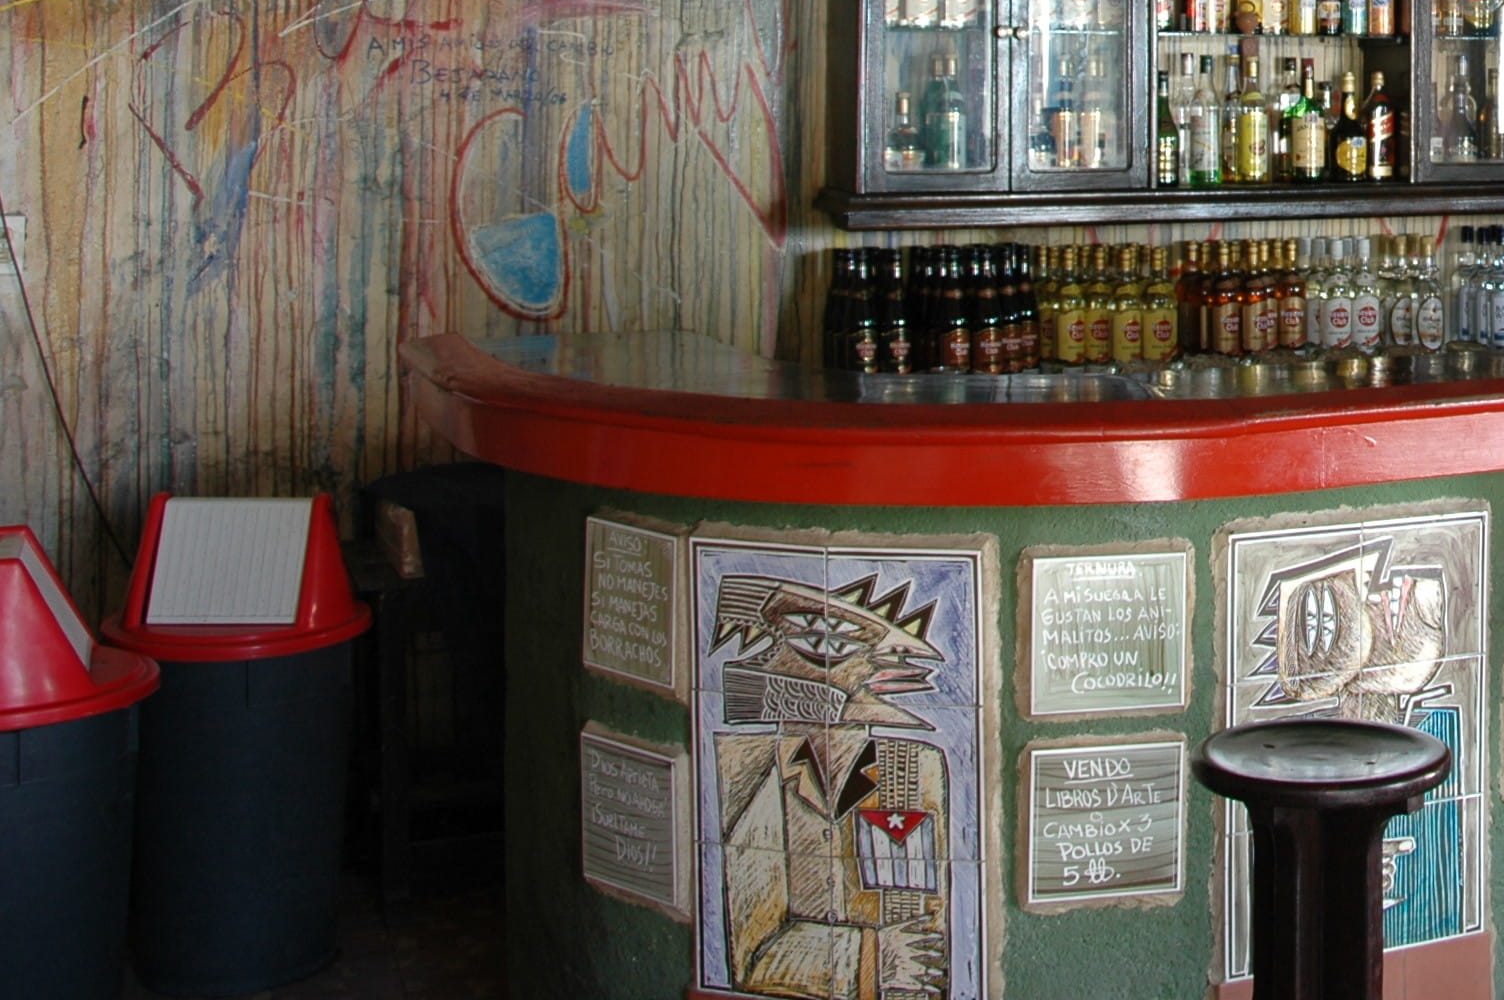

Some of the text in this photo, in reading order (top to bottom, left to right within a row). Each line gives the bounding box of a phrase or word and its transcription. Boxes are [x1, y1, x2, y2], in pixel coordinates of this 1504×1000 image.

[612, 553, 653, 579] TOMAS
[597, 573, 668, 602] NO MANEJES
[1043, 588, 1059, 605] A
[1150, 586, 1167, 601] LE
[608, 595, 658, 623] MANEJAS
[1040, 608, 1102, 627] GUSTAN
[1108, 606, 1133, 623] LOS
[589, 628, 662, 668] BORRACHOS
[628, 622, 649, 640] CON
[650, 629, 668, 648] LOS
[1113, 650, 1139, 667] UN
[1062, 757, 1131, 779] VENDO
[1045, 786, 1102, 809] LIBROS
[1042, 821, 1117, 839] CAMBIO
[1137, 813, 1153, 833] 3
[1055, 836, 1154, 862] POLLOS DE
[1062, 865, 1080, 887] 5
